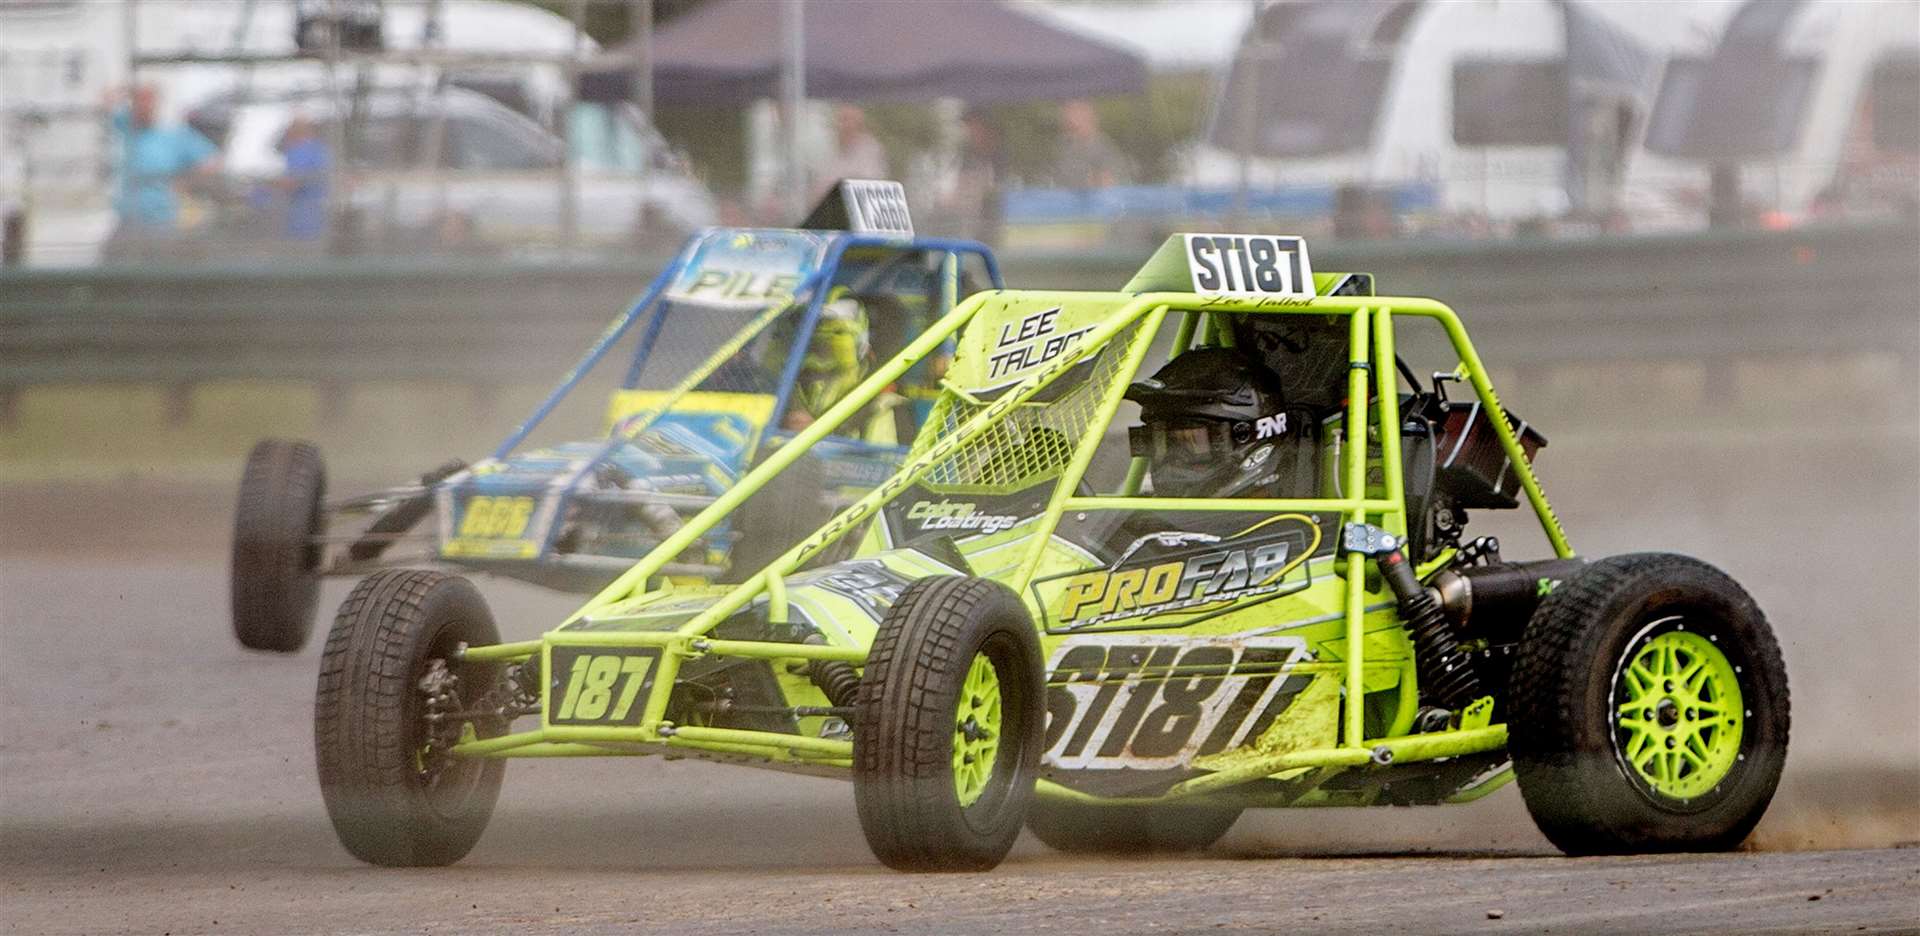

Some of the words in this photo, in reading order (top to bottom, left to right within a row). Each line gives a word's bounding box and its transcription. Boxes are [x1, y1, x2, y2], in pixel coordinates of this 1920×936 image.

[1190, 236, 1302, 293] ST187
[1200, 295, 1242, 308] Lee
[998, 306, 1062, 348] LEE
[880, 423, 976, 499] RACE
[986, 347, 1085, 419] CARS
[906, 499, 977, 519] Cobra
[920, 510, 1019, 535] Coatings
[1060, 542, 1289, 622] PROFAB
[557, 654, 654, 720] 187
